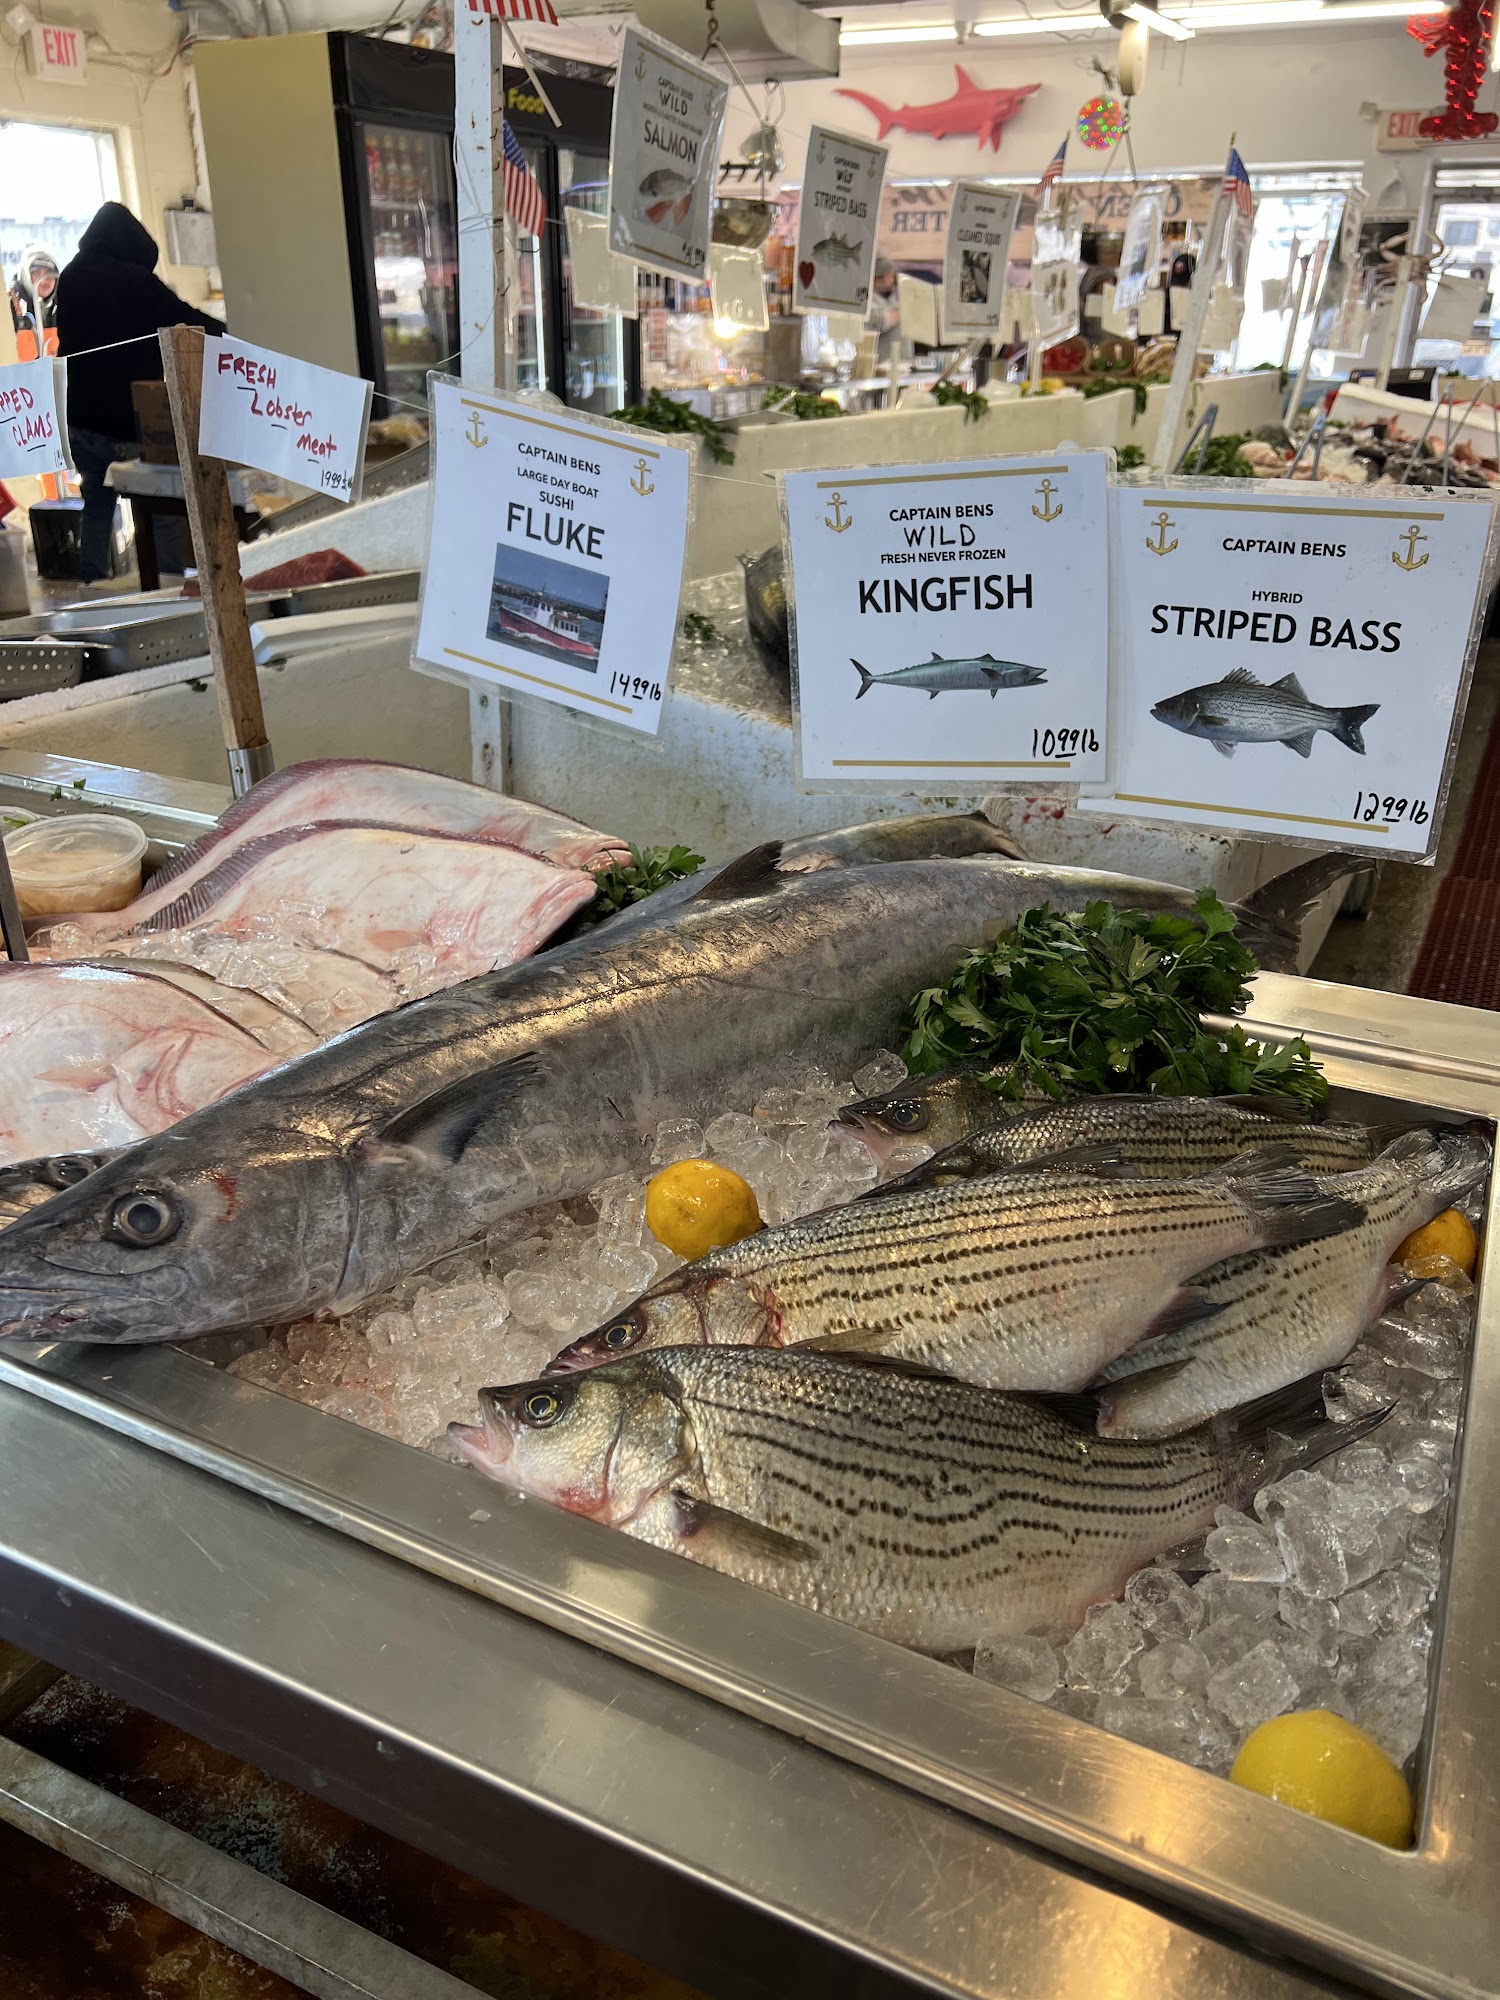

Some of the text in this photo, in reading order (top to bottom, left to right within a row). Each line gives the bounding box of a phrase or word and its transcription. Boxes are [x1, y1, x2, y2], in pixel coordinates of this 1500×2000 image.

[43, 28, 77, 67] EXIT
[659, 89, 688, 116] WILD
[644, 119, 698, 164] SALMON
[218, 353, 276, 389] FRESH
[12, 411, 53, 447] CLAMS
[518, 443, 601, 475] CAPTAIN BENS
[517, 467, 599, 498] LARGE DAY BOAT
[539, 491, 574, 511] SUSHI
[889, 503, 994, 521] CAPTAIN BENS
[507, 501, 605, 560] FLUKE
[903, 523, 976, 548] WILD
[881, 549, 1006, 564] FRESH NEVER FROZEN
[1222, 537, 1347, 558] CAPTAIN BENS
[859, 573, 1033, 614] KINGFISH
[1251, 590, 1303, 604] HYBRID
[1150, 604, 1402, 653] STRIPED BASS
